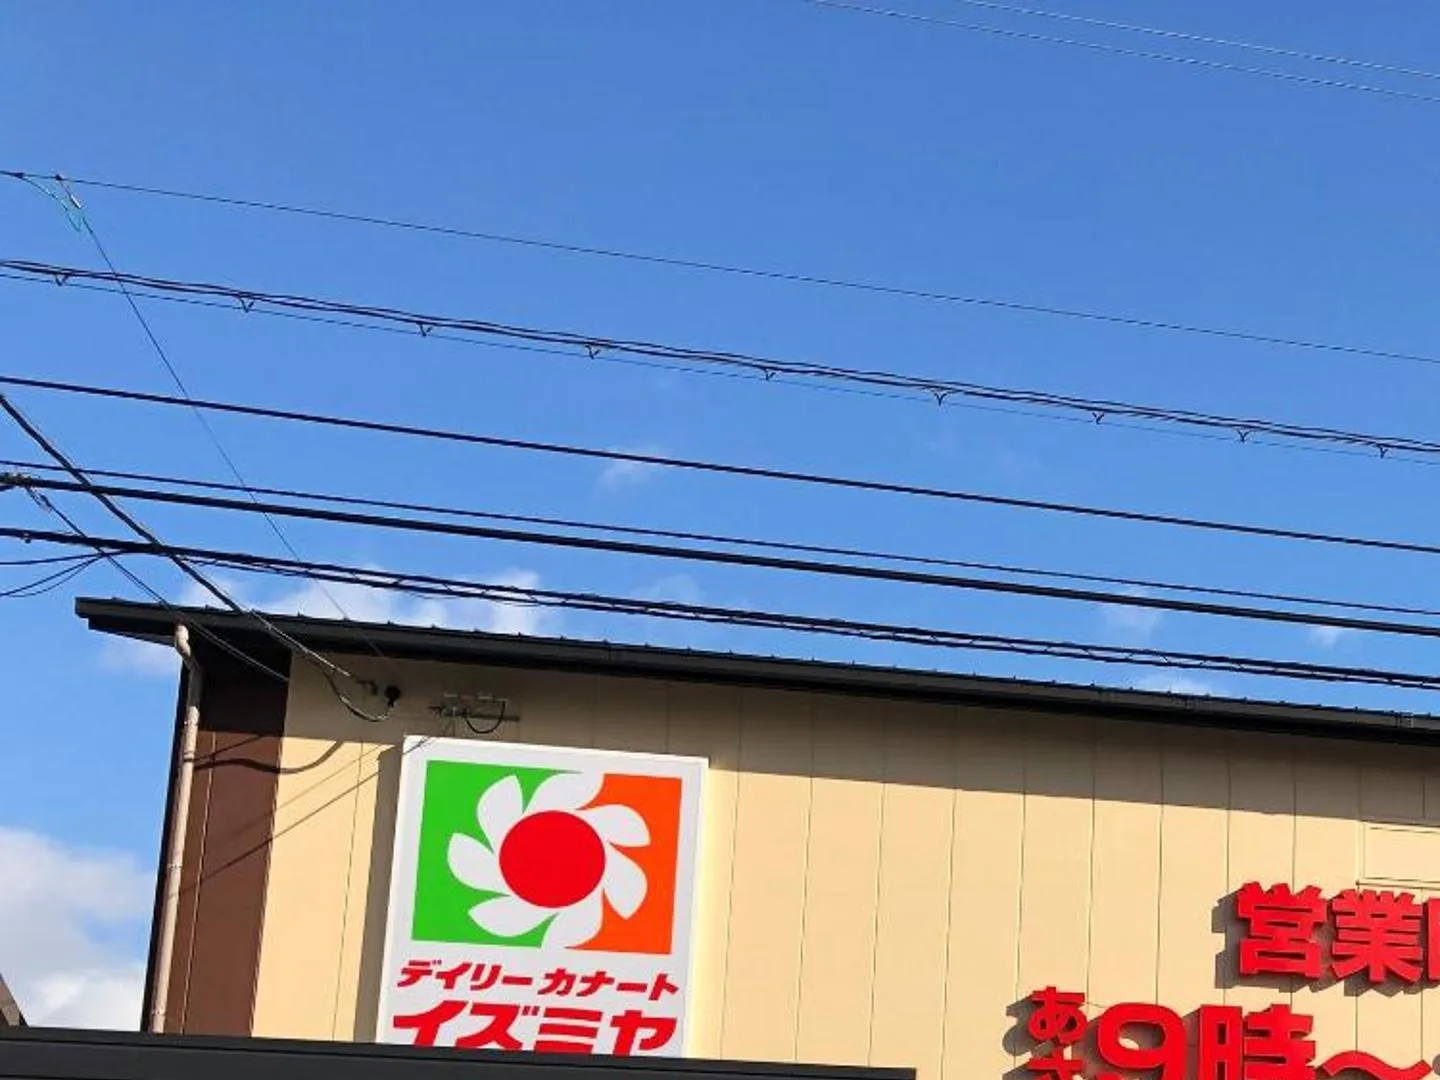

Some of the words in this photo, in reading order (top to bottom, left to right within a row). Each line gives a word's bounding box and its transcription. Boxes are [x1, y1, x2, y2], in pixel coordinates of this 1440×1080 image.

[397, 959, 679, 1002] デイリーカナート
[393, 999, 678, 1057] イズミヤ
